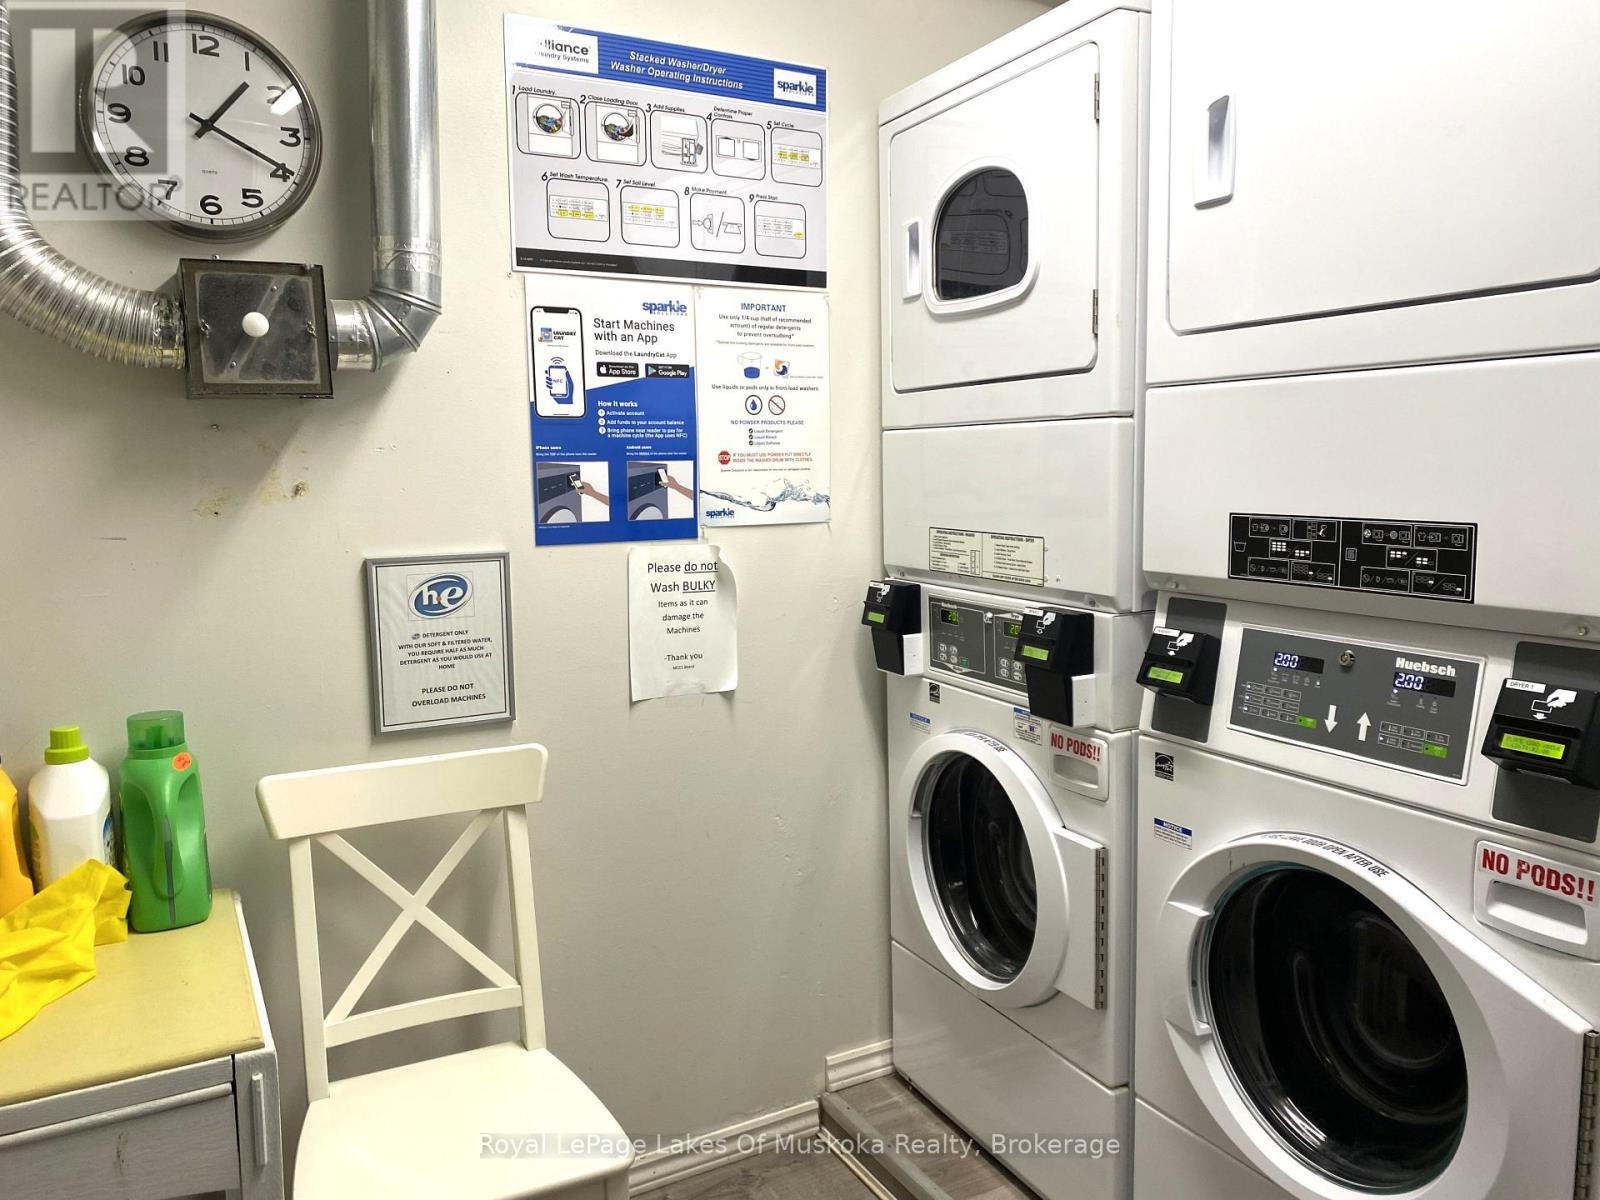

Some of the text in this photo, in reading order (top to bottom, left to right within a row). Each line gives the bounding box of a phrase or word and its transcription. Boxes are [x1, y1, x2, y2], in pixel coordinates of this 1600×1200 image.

[153, 41, 169, 62] 11
[192, 33, 220, 57] 12
[245, 52, 250, 71] 1
[563, 54, 589, 63] Systems
[629, 51, 726, 74] Stacked Washer/Dryer
[122, 64, 146, 86] 10
[611, 61, 743, 89] Washer Operating Instructions
[512, 85, 516, 94] 1
[534, 87, 555, 95] Laundry
[580, 95, 586, 104] 2
[605, 97, 624, 106] Loading
[107, 103, 131, 123] 9
[646, 104, 651, 112] 3
[664, 104, 685, 114] Supplies
[706, 113, 712, 121] 4
[767, 121, 772, 130] 5
[280, 127, 301, 147] 3
[124, 146, 149, 166] 8
[270, 163, 290, 182] 4
[542, 172, 548, 181] 6
[575, 174, 608, 182] Temperature
[158, 180, 178, 200] 7
[616, 179, 621, 188] 7
[242, 188, 263, 208] 5
[684, 187, 690, 195] 8
[749, 194, 754, 202] 9
[200, 195, 222, 215] 6
[741, 303, 786, 312] IMPORTANT
[594, 318, 675, 331] Start Machines
[594, 331, 617, 341] with
[637, 333, 658, 345] App
[647, 561, 718, 573] Please do not
[651, 580, 715, 593] Wash BULKY
[662, 613, 690, 622] damage
[667, 626, 700, 634] Machines
[1275, 653, 1298, 668] 2.00
[1396, 657, 1456, 677] Huebsch
[1395, 673, 1424, 690] 2.00
[422, 686, 446, 694] PLEASE
[412, 694, 486, 707] OVERLOAD MACHINES
[1051, 733, 1100, 761] NO PODS!!
[1163, 821, 1182, 833] NOTICE
[1322, 844, 1347, 856] OPEN
[1343, 854, 1373, 868] AFTER
[1368, 866, 1390, 877] USE
[1482, 848, 1594, 901] NO PODS!!
